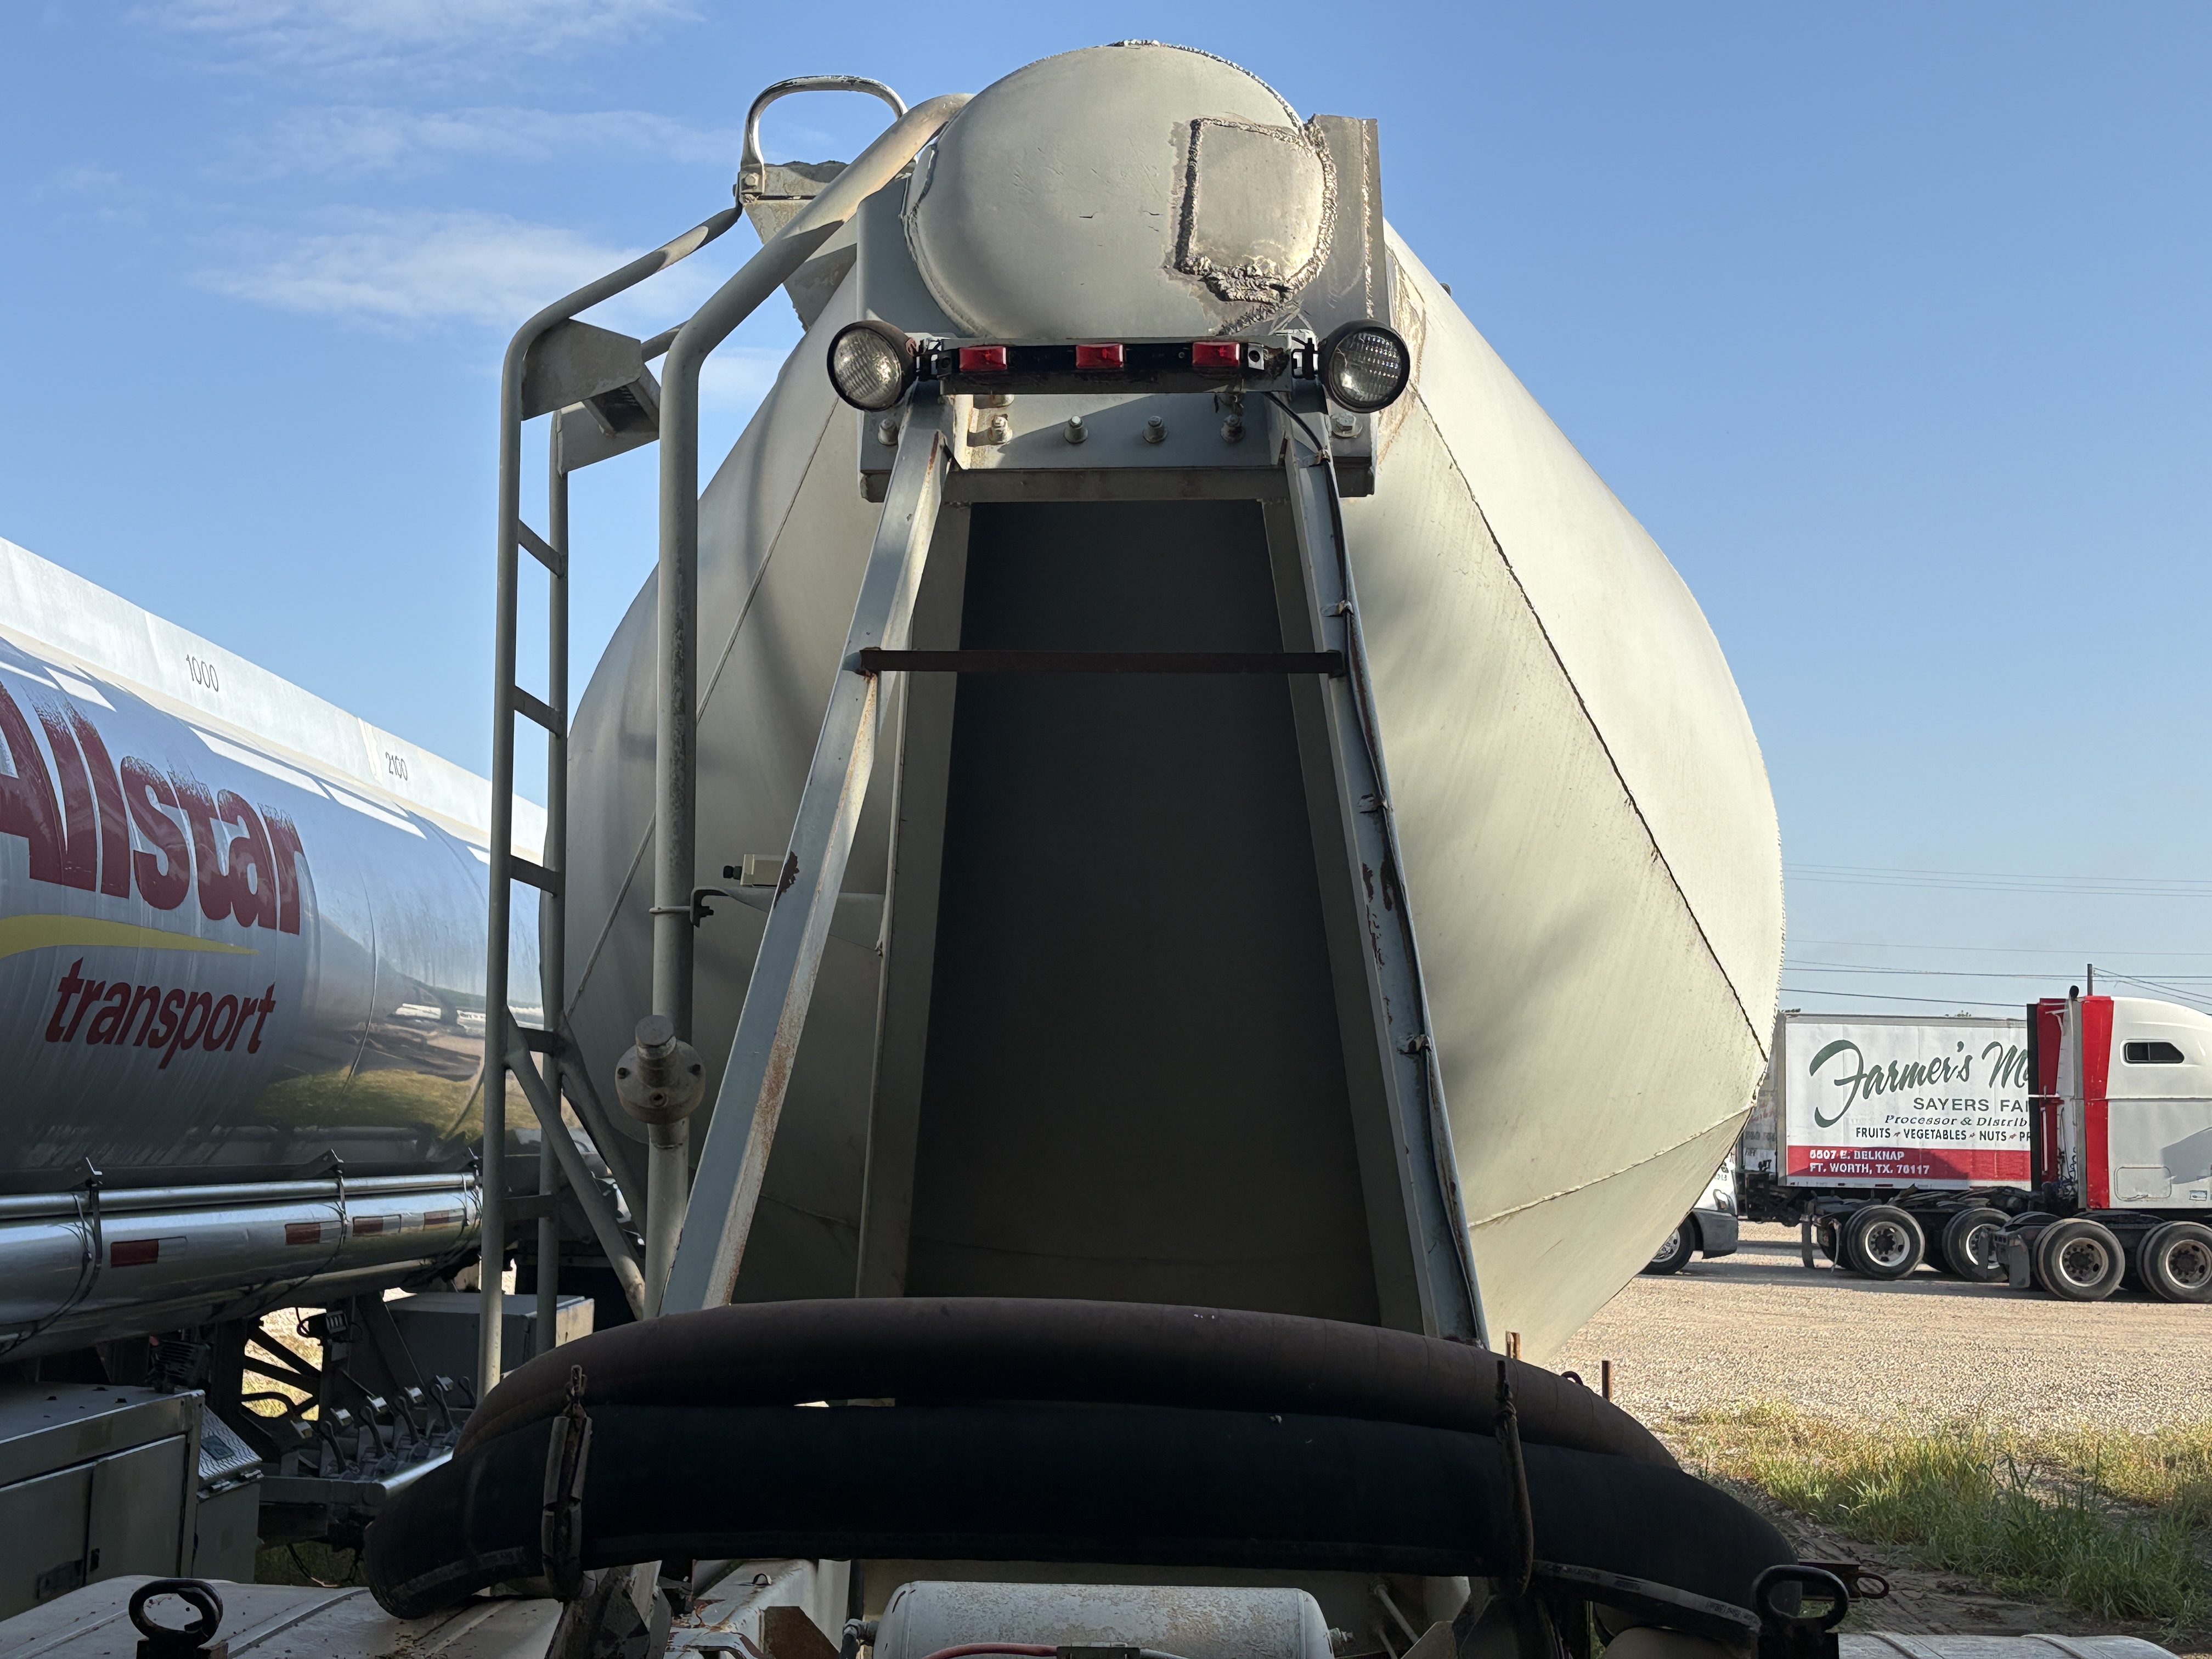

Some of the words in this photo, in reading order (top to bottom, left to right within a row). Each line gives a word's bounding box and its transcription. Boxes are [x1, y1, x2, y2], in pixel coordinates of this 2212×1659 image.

[186, 654, 219, 692] 1000
[385, 752, 408, 781] 2100
[46, 957, 276, 1069] transport
[1809, 1039, 1973, 1128] Farmer's
[1913, 1097, 1990, 1112] SAYERS
[1960, 1117, 1972, 1126] &
[1976, 1117, 2030, 1127] Distrib
[1855, 1127, 1891, 1139] FRUITS
[1903, 1128, 1967, 1141] VEGETABLES
[1979, 1130, 2007, 1142] NUTS
[1809, 1162, 1827, 1173] FT.
[1829, 1163, 1873, 1175] WORTH,
